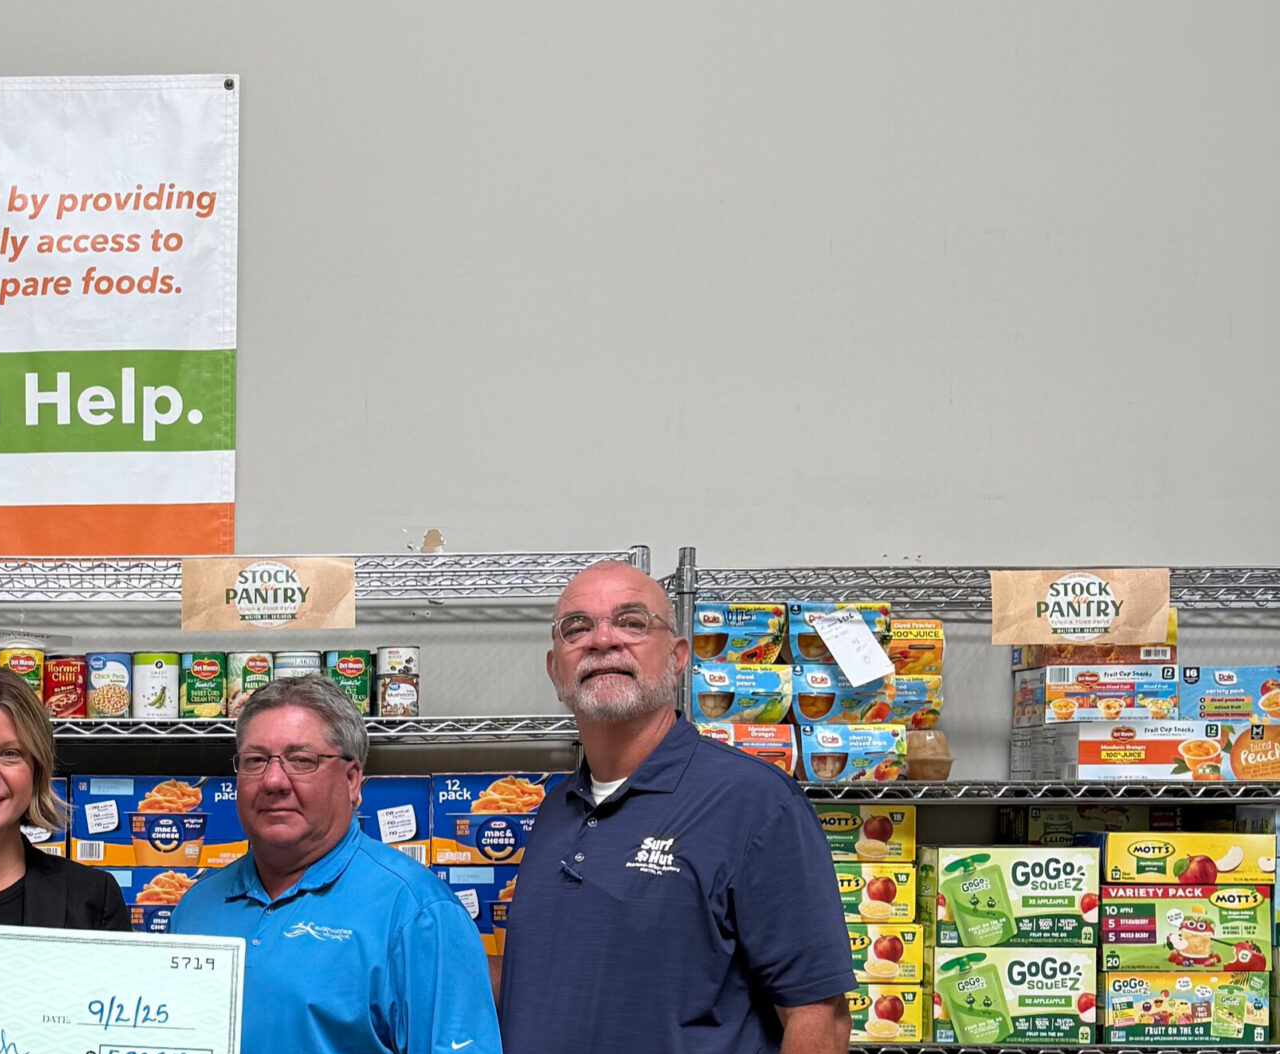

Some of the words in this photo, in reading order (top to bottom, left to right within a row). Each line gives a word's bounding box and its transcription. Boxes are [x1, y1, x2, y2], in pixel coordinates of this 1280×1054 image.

[7, 185, 50, 220] by
[56, 184, 217, 219] providing
[36, 231, 142, 255] access
[149, 229, 184, 252] to
[80, 267, 183, 296] foods.
[25, 366, 203, 446] Help.
[239, 570, 297, 584] STOCK
[226, 587, 309, 604] PANTRY
[1050, 582, 1111, 597] STOCK
[1036, 600, 1124, 618] PANTRY
[702, 614, 720, 624] Dole
[913, 629, 941, 639] JUICE
[48, 663, 81, 674] Hormel
[52, 672, 76, 682] Chili
[708, 674, 727, 684] Dole
[1121, 751, 1143, 759] JUICE
[439, 789, 471, 803] pack
[484, 829, 505, 838] mac
[481, 836, 516, 845] cheese
[641, 837, 674, 851] Surf
[1133, 843, 1170, 853] MOTT'S
[648, 850, 674, 865] Hut
[1011, 858, 1075, 887] GoGo
[1031, 878, 1083, 891] SQUEEZ
[1108, 887, 1164, 898] VARIETY
[1168, 887, 1203, 897] PACK
[1216, 892, 1258, 903] MOTT'S
[1104, 905, 1118, 916] 10
[170, 957, 216, 970] 5719
[1106, 957, 1120, 967] 20
[1007, 957, 1071, 985] GoGo
[1027, 978, 1080, 990] SQUEEZ
[88, 995, 169, 1030] 9/2/25
